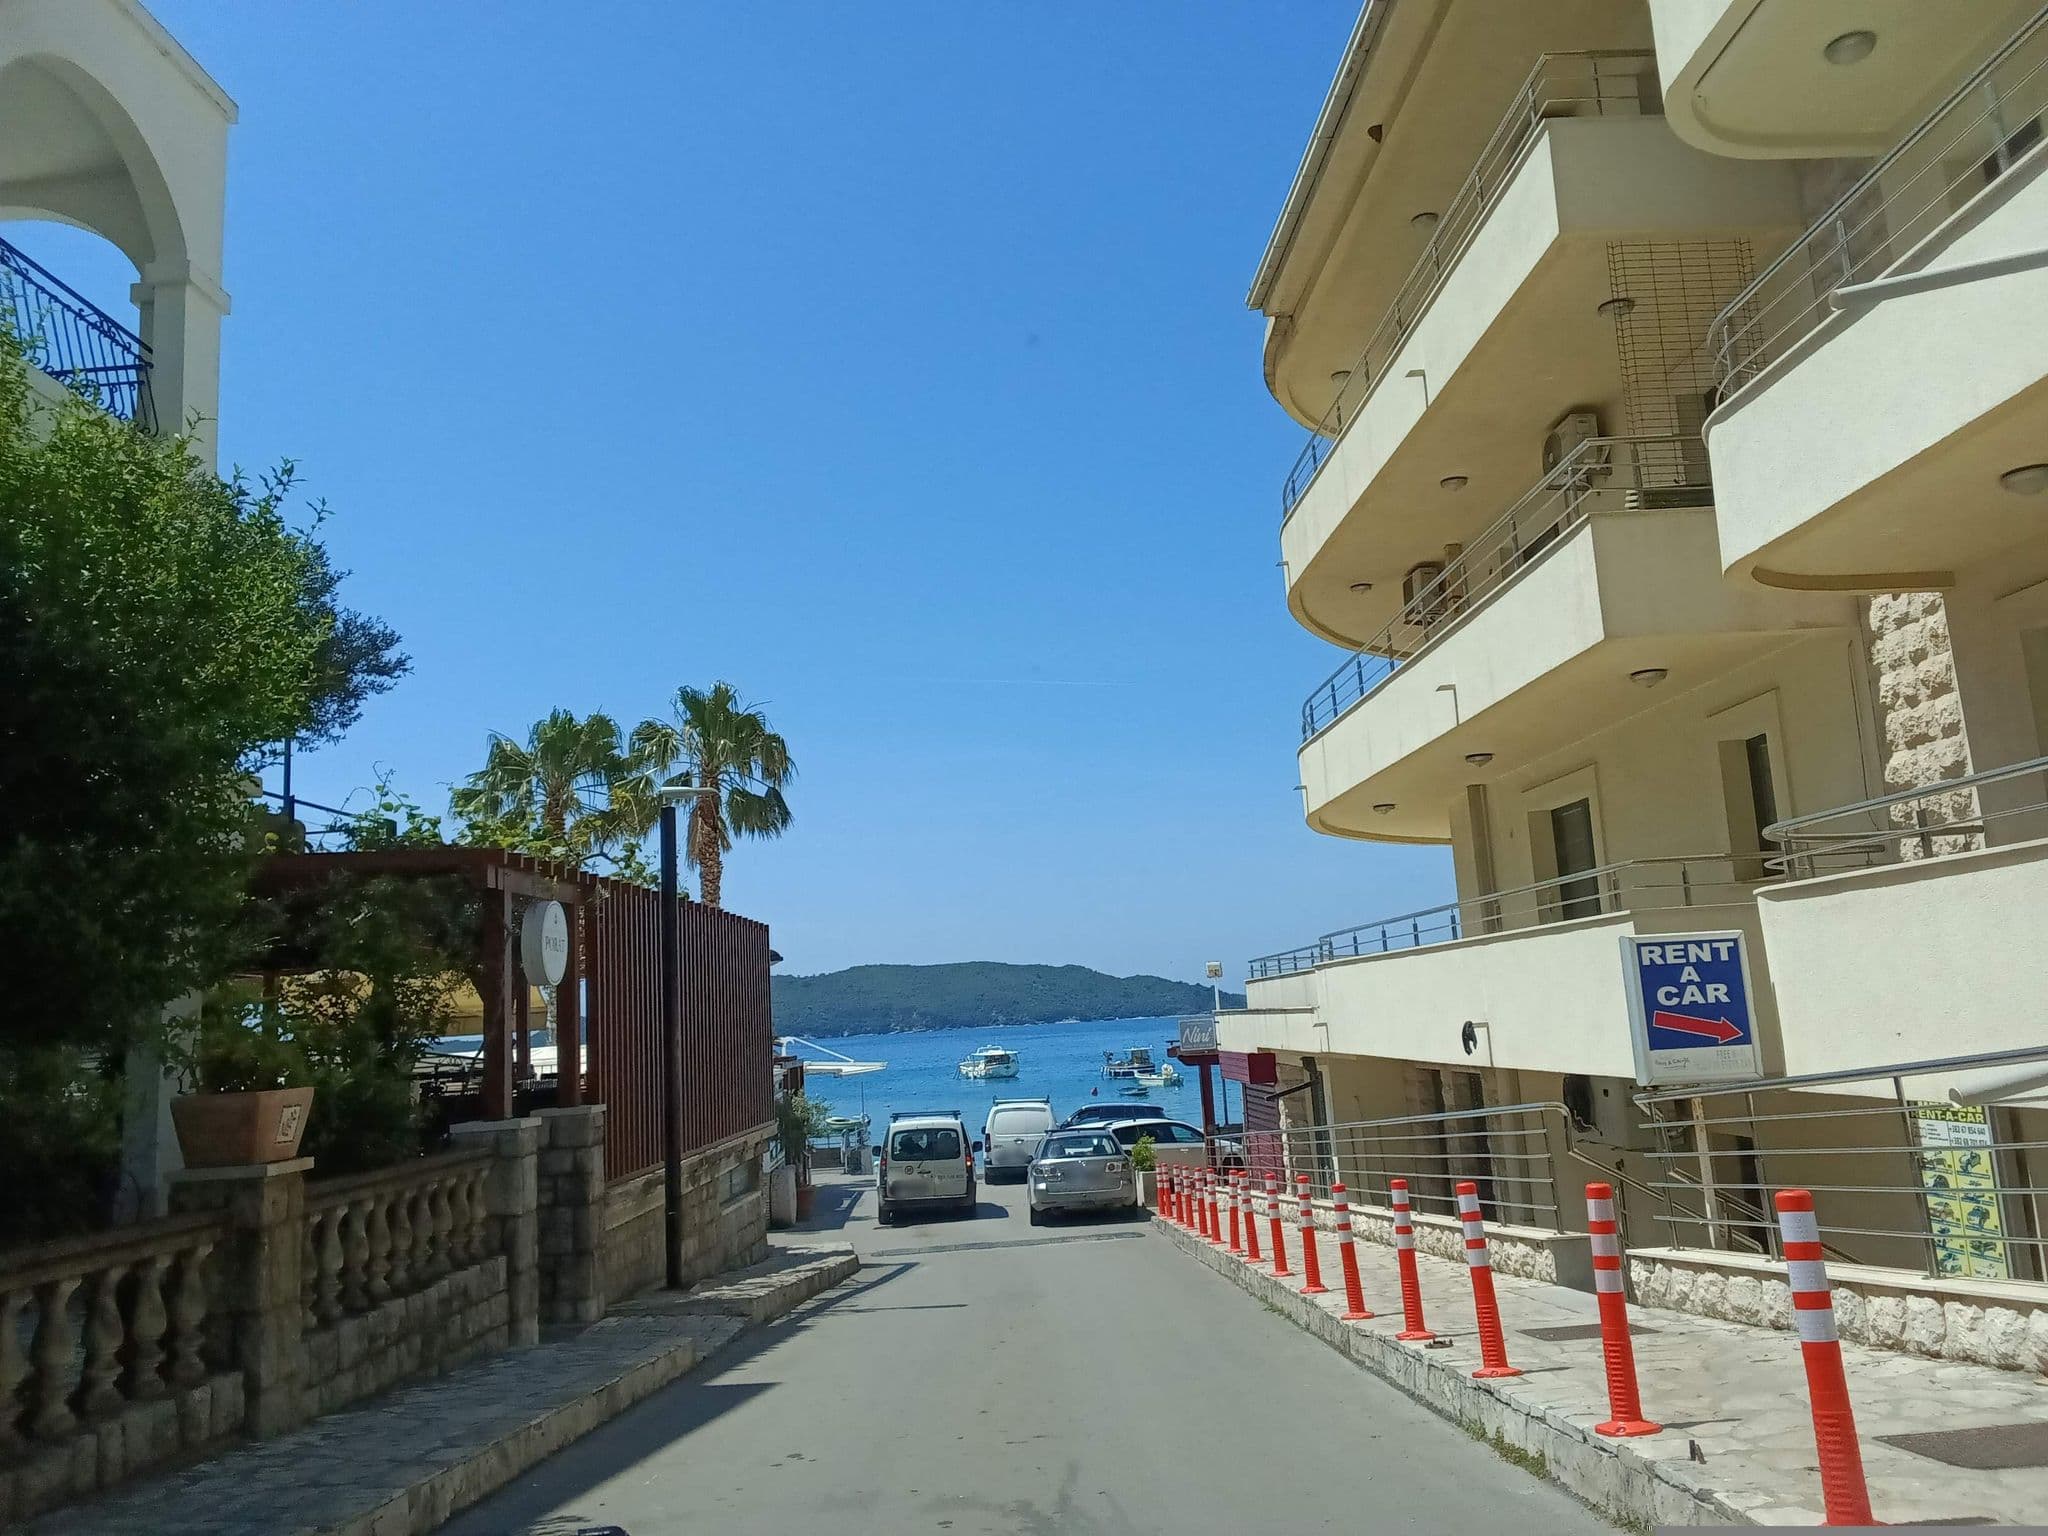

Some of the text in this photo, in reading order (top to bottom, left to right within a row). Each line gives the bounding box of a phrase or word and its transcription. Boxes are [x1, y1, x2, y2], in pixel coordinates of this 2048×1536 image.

[1640, 942, 1735, 966] RENT
[1679, 966, 1701, 984] A
[1656, 983, 1731, 1007] CAR
[1183, 1026, 1212, 1043] Nini
[1909, 1109, 1985, 1123] RENT-A-CAR
